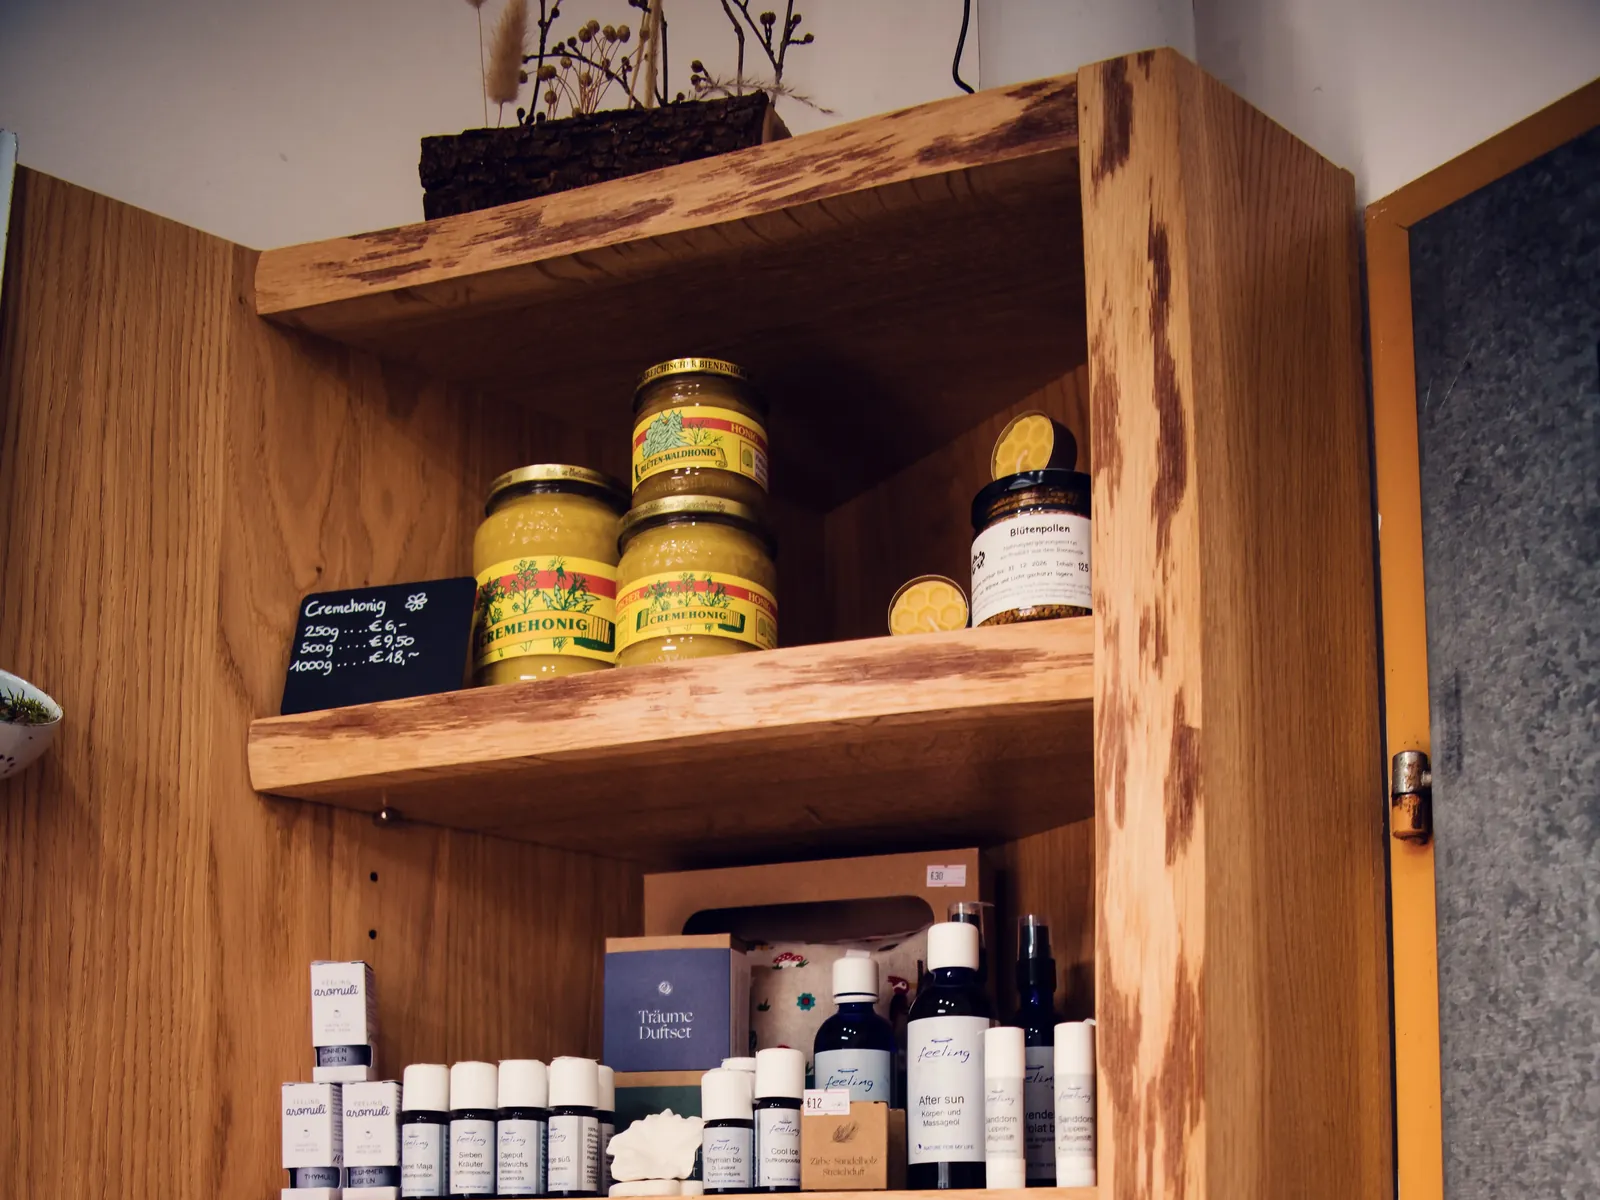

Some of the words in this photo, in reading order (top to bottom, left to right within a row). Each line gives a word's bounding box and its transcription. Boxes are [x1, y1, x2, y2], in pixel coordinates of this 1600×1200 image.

[640, 448, 716, 473] BLÜTEN-WALDHONIG
[1010, 524, 1070, 537] Blütenpollen
[1078, 563, 1089, 572] 125
[305, 599, 386, 618] Cremehonig
[650, 611, 727, 625] CREMEHONIG
[304, 625, 339, 643] 250g
[300, 642, 334, 657] 500g
[289, 660, 333, 676] 1000g
[314, 985, 359, 996] aromuli
[638, 1009, 694, 1024] Träume
[639, 1024, 692, 1040] Duftset
[918, 1045, 970, 1063] feeling
[825, 1075, 874, 1092] feeling
[807, 1097, 822, 1109] €12
[919, 1095, 941, 1106] After
[944, 1095, 965, 1104] sun
[286, 1104, 327, 1116] aromuli
[346, 1106, 390, 1117] aromuli
[923, 1118, 960, 1127] Massageöl
[769, 1125, 800, 1136] feeling
[709, 1143, 740, 1154] feeling
[500, 1152, 523, 1160] Cajeput
[823, 1168, 865, 1176] Streichduft
